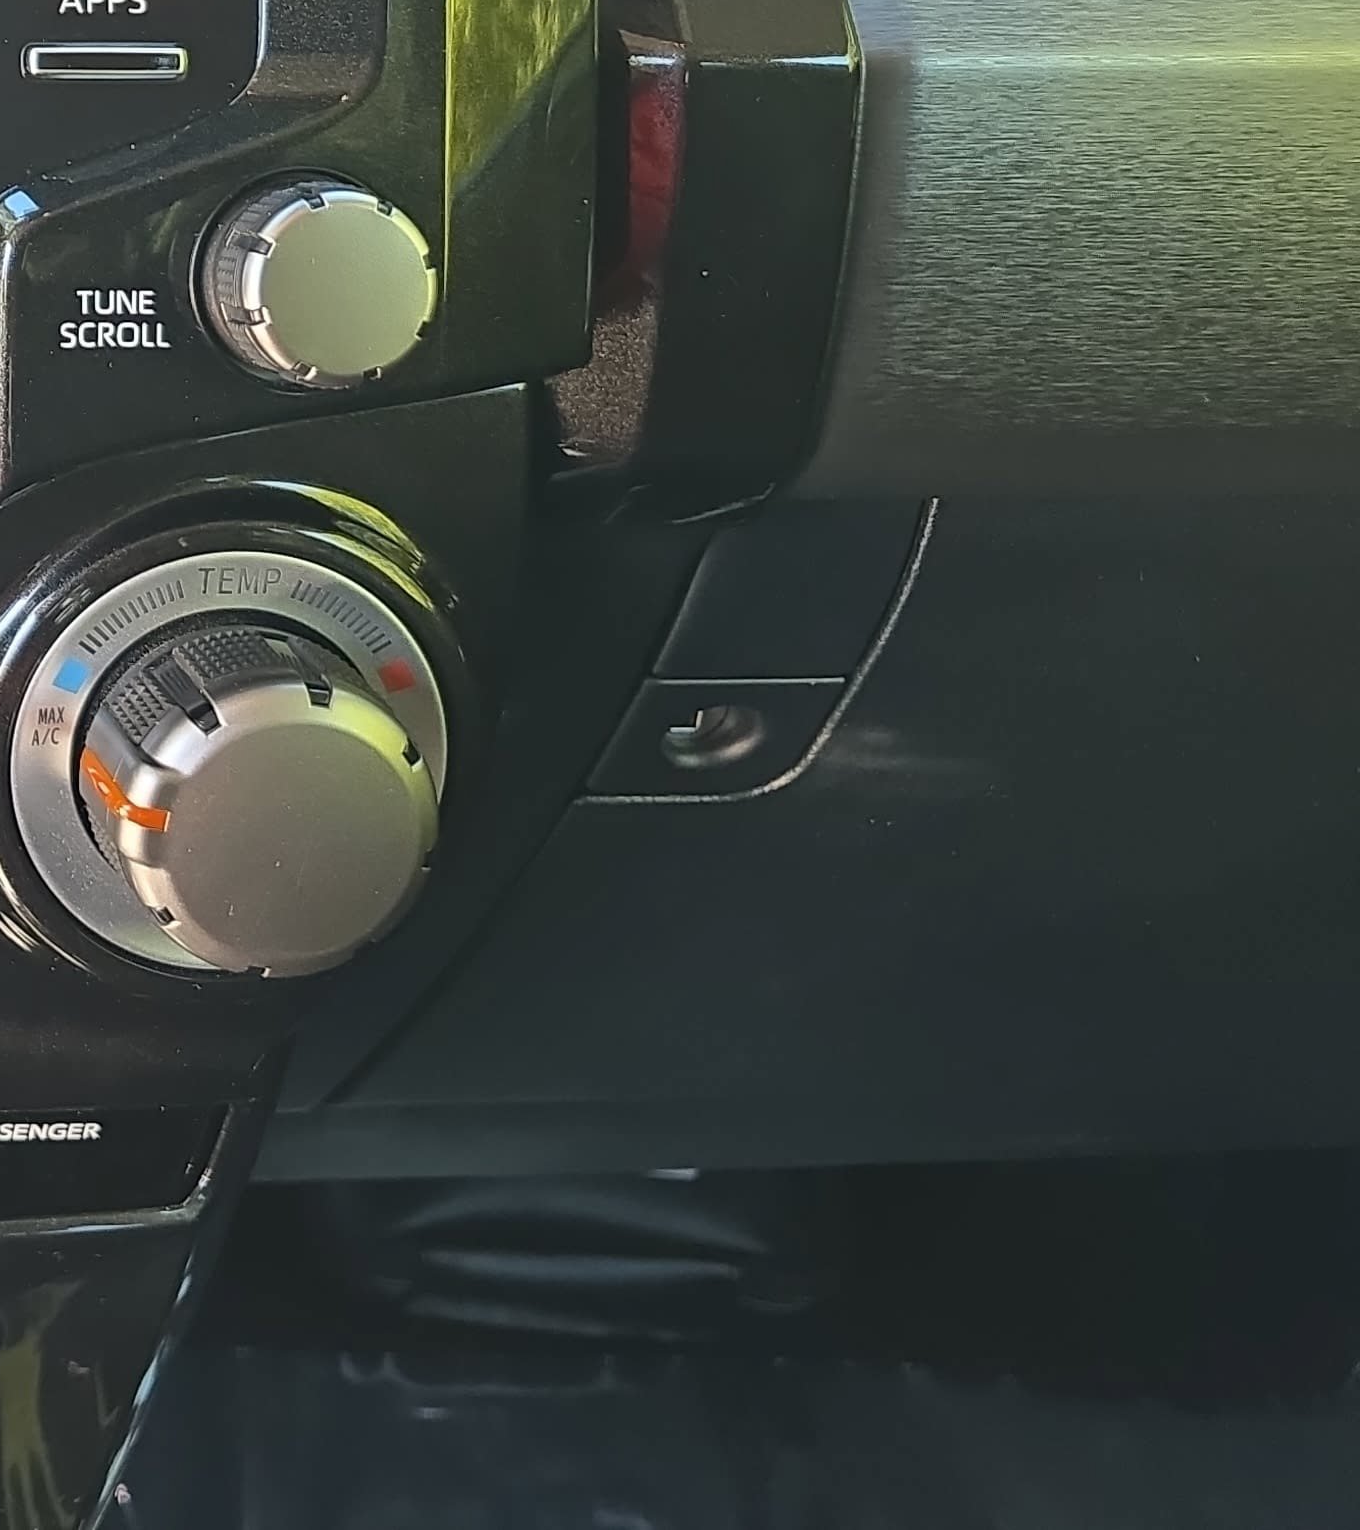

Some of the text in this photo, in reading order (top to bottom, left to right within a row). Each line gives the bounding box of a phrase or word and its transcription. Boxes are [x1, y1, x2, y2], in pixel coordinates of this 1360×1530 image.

[76, 289, 156, 315] TUNE
[59, 322, 172, 349] SCROLL
[198, 567, 283, 596] TEMP
[37, 706, 66, 725] MAX
[31, 728, 61, 747] A/C
